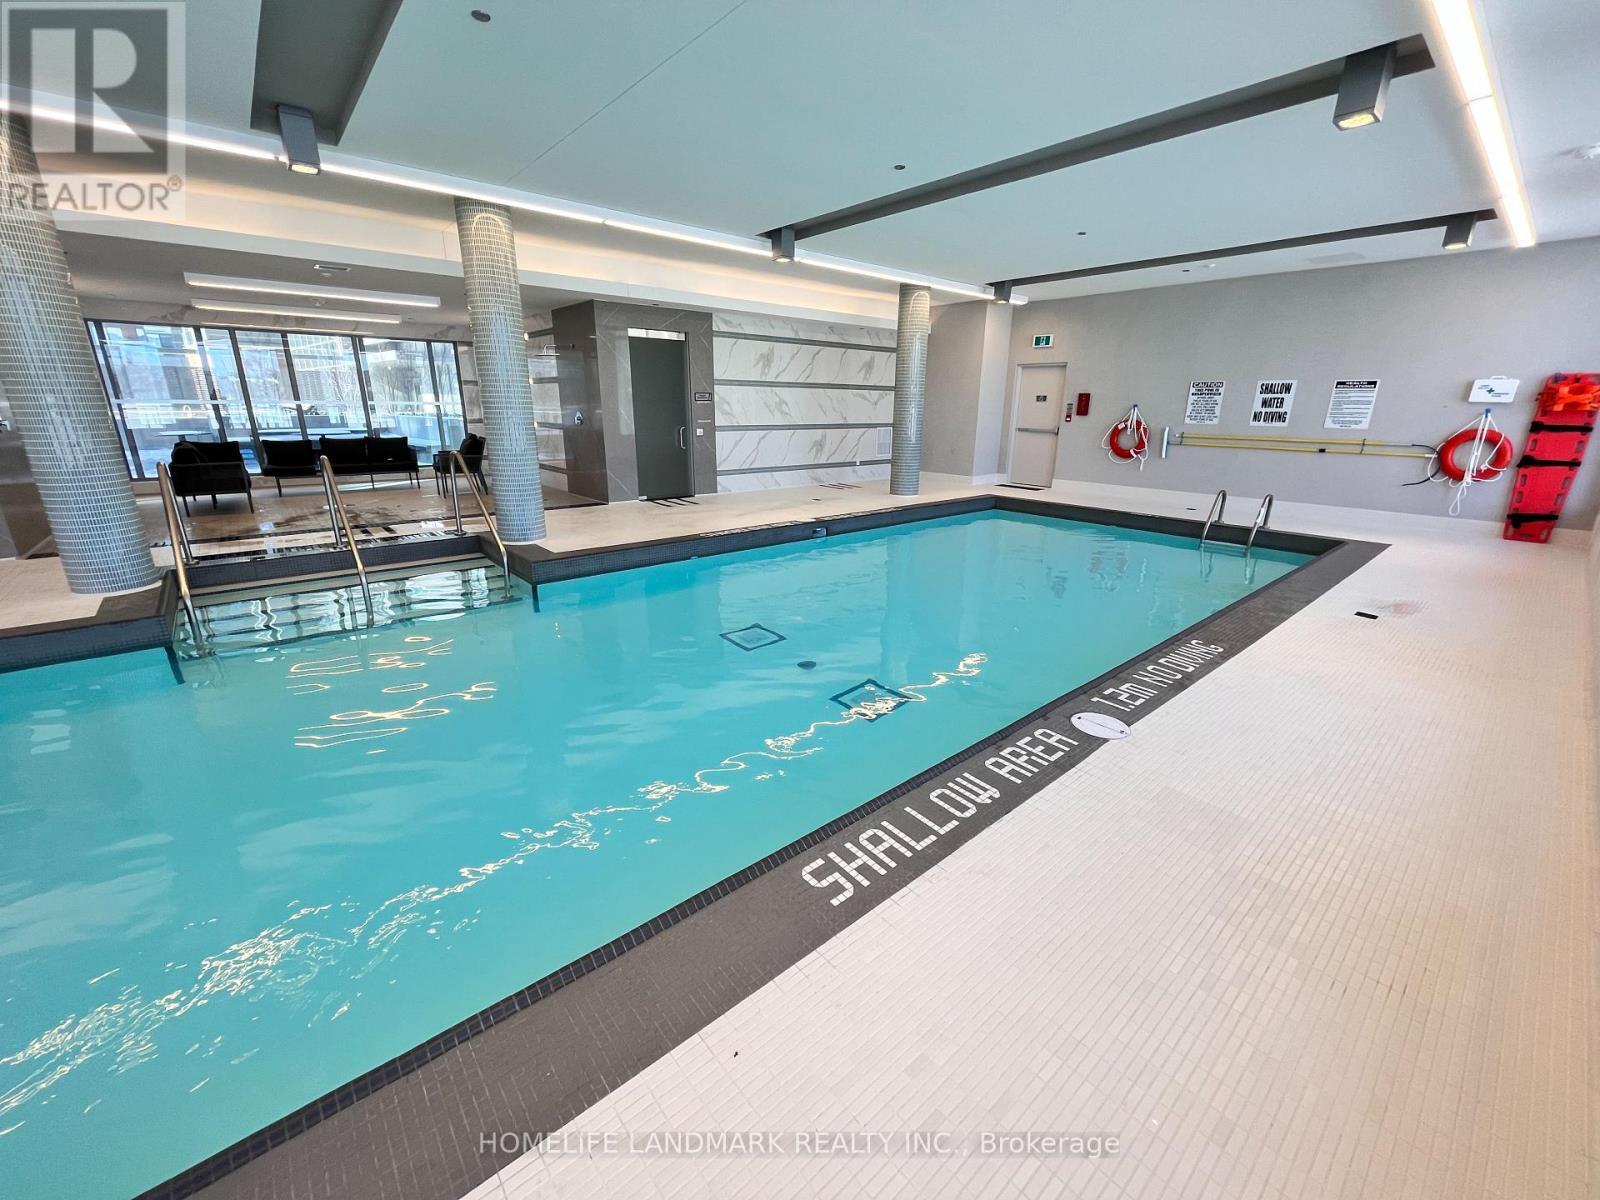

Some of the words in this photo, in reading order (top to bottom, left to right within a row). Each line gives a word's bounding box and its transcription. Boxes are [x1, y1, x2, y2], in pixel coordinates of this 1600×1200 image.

[1260, 383, 1293, 395] SHALLOW
[1261, 397, 1285, 409] WATER
[1252, 411, 1263, 423] NO
[1263, 411, 1288, 423] DIVING
[1132, 665, 1182, 687] NO
[1158, 639, 1224, 672] DIVING
[802, 772, 1001, 906] SHALLOW
[984, 728, 1079, 784] AREA
